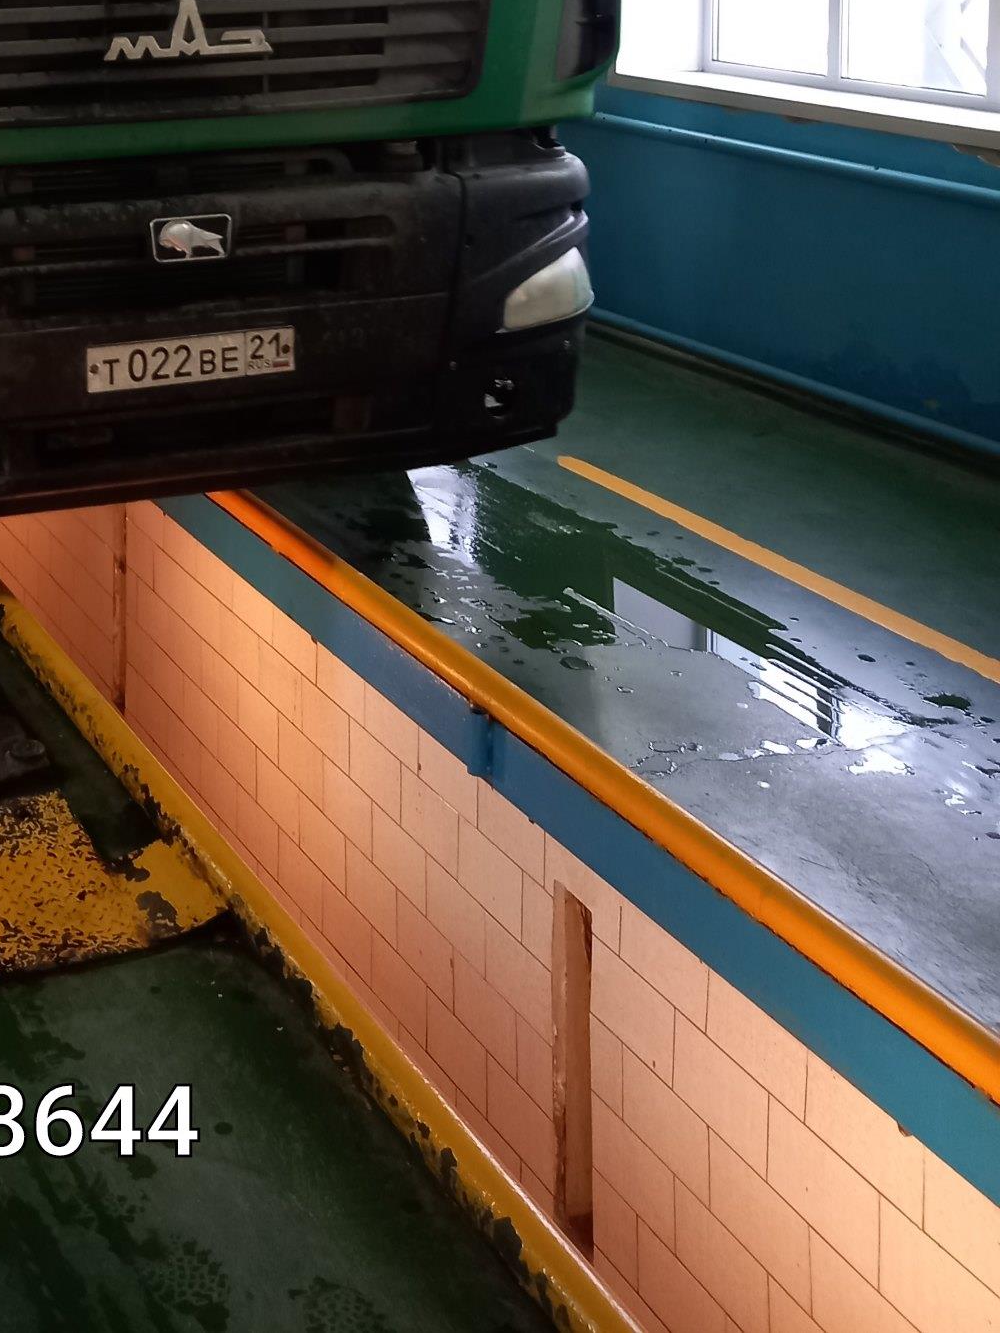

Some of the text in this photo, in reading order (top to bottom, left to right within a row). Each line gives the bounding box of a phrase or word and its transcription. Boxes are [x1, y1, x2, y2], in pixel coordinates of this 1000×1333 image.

[102, 332, 282, 385] Т022ВЕ 21
[248, 357, 271, 371] RUS
